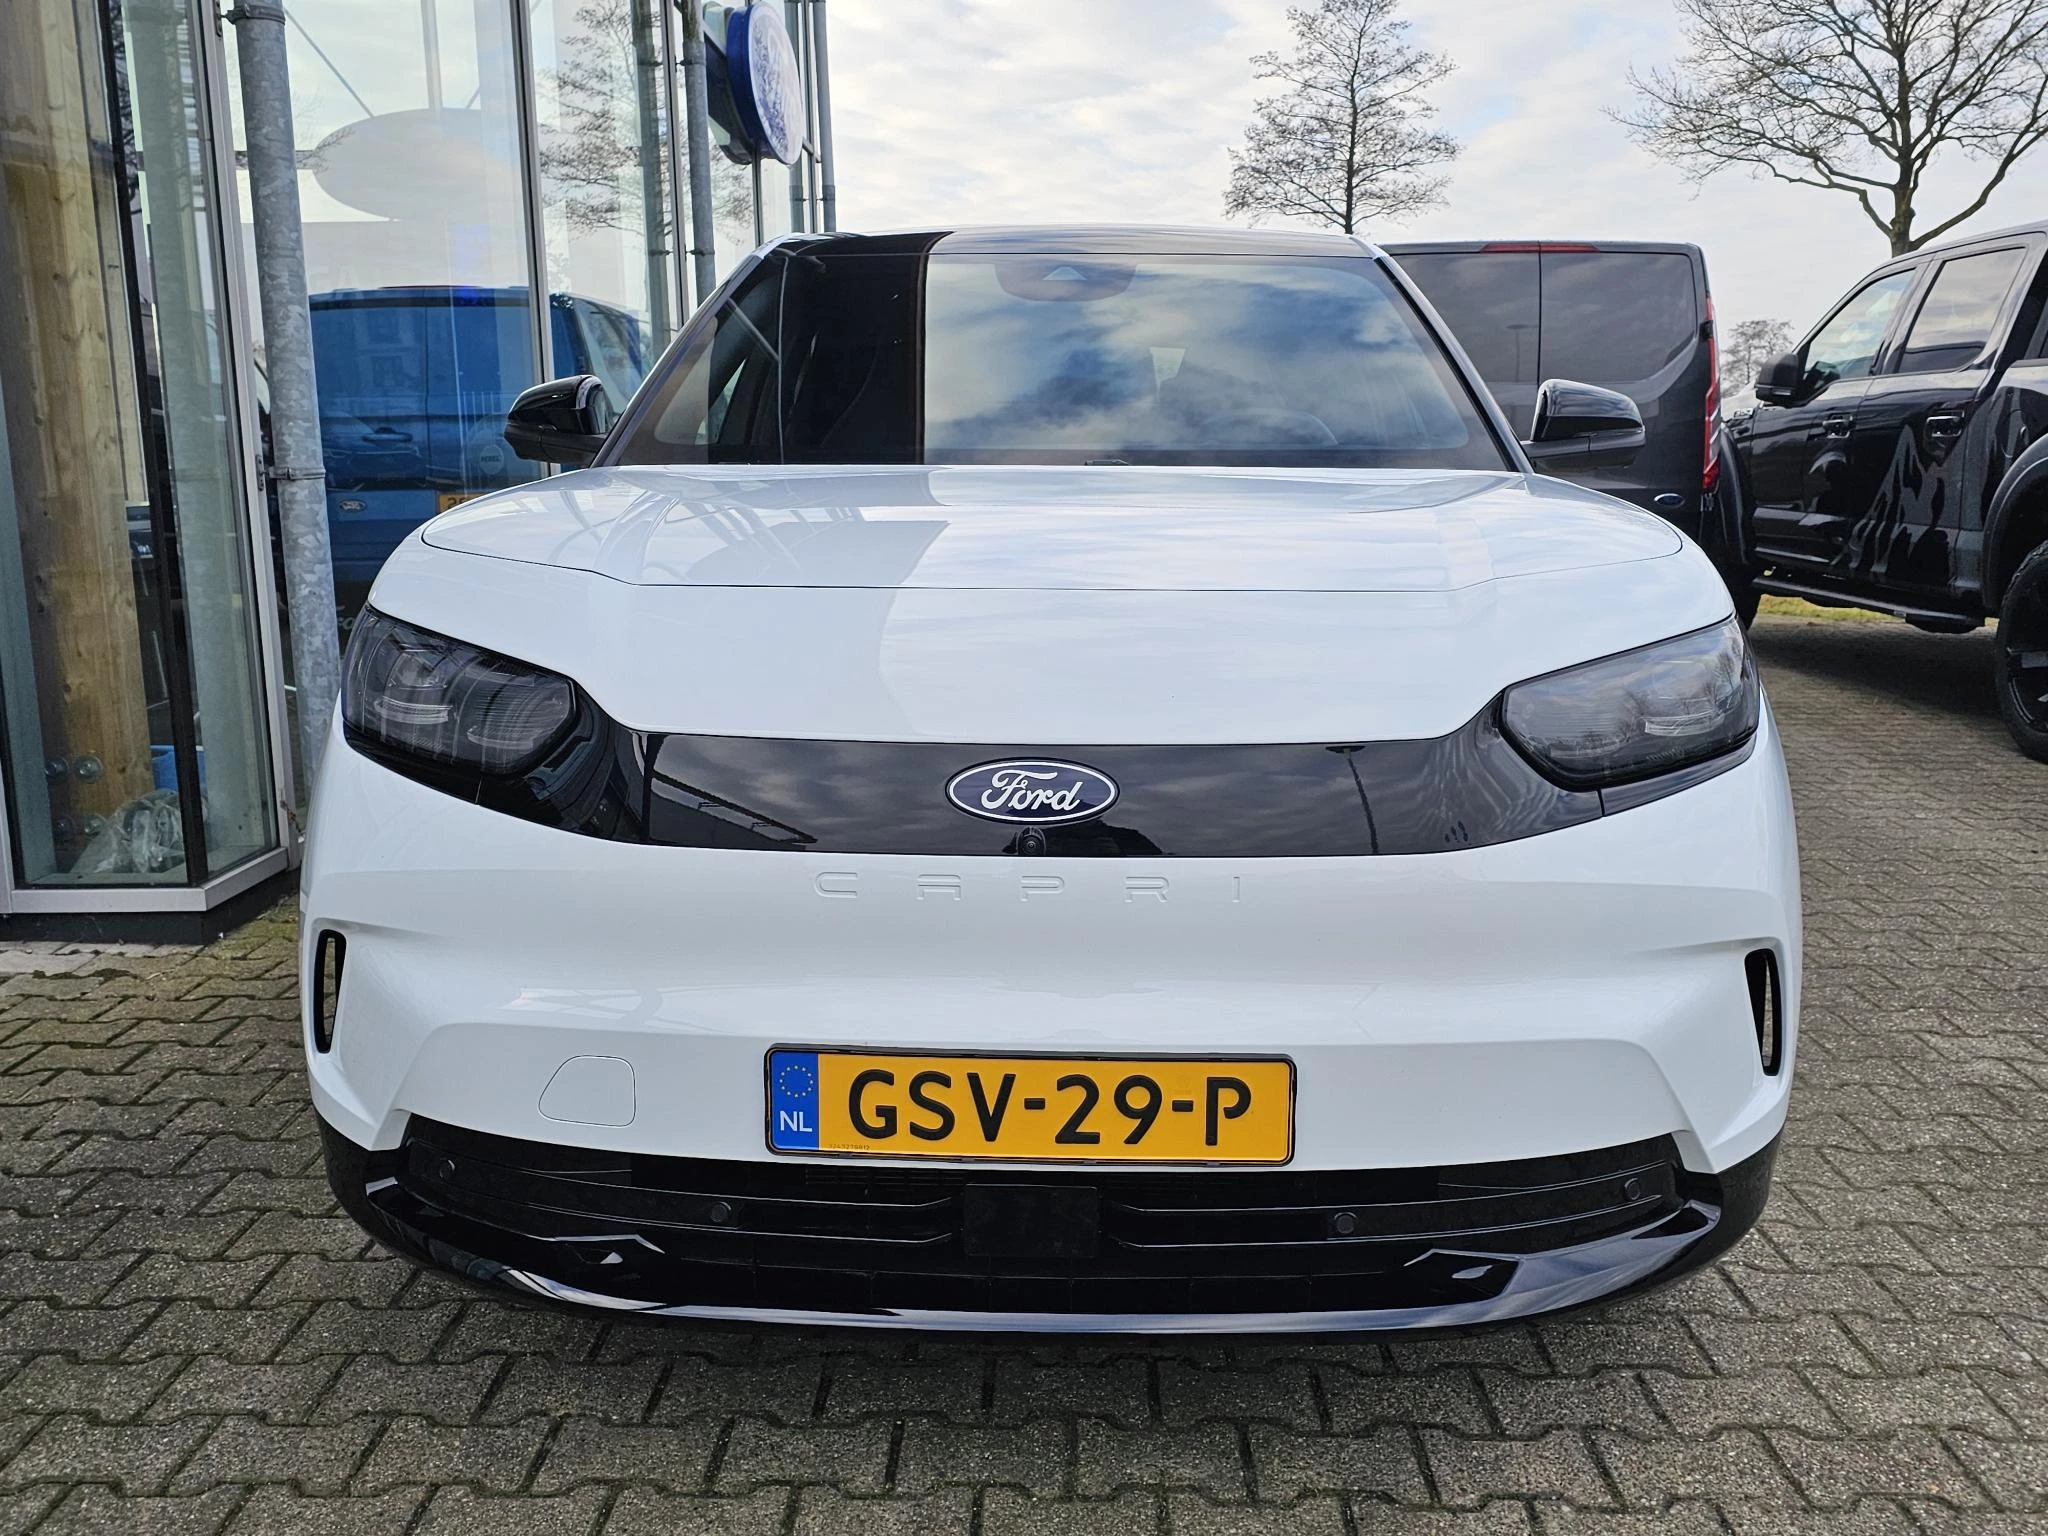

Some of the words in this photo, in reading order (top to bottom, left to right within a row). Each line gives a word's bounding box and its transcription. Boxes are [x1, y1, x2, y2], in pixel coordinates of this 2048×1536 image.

[980, 768, 1083, 811] Ford
[813, 871, 1241, 903] CAPRI
[779, 1110, 813, 1133] NL
[847, 1068, 1252, 1147] GSV-29-P
